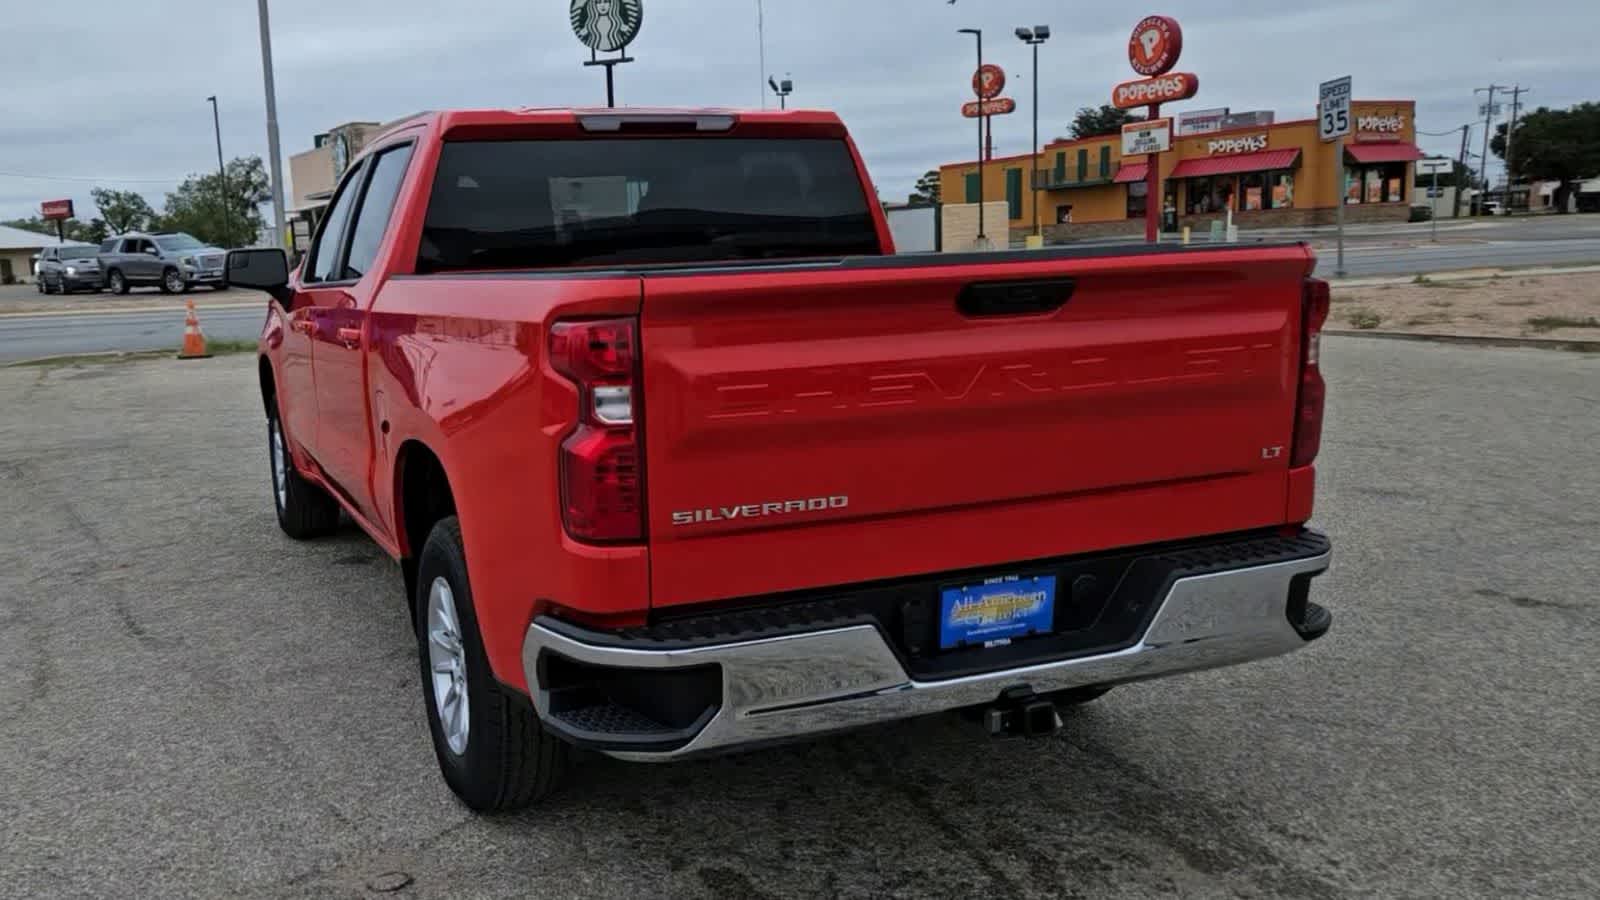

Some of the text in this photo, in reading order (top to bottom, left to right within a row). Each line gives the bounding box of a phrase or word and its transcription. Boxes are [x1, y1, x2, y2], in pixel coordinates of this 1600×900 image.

[1139, 28, 1161, 60] P
[1119, 76, 1183, 103] POPEYES
[1321, 84, 1349, 98] SPEED
[1323, 97, 1346, 112] LIMIT
[1324, 111, 1348, 134] 35
[1358, 116, 1405, 132] POPEYES
[1208, 136, 1266, 153] POPEYES
[1262, 445, 1283, 458] LT
[672, 495, 849, 525] SILVERADO
